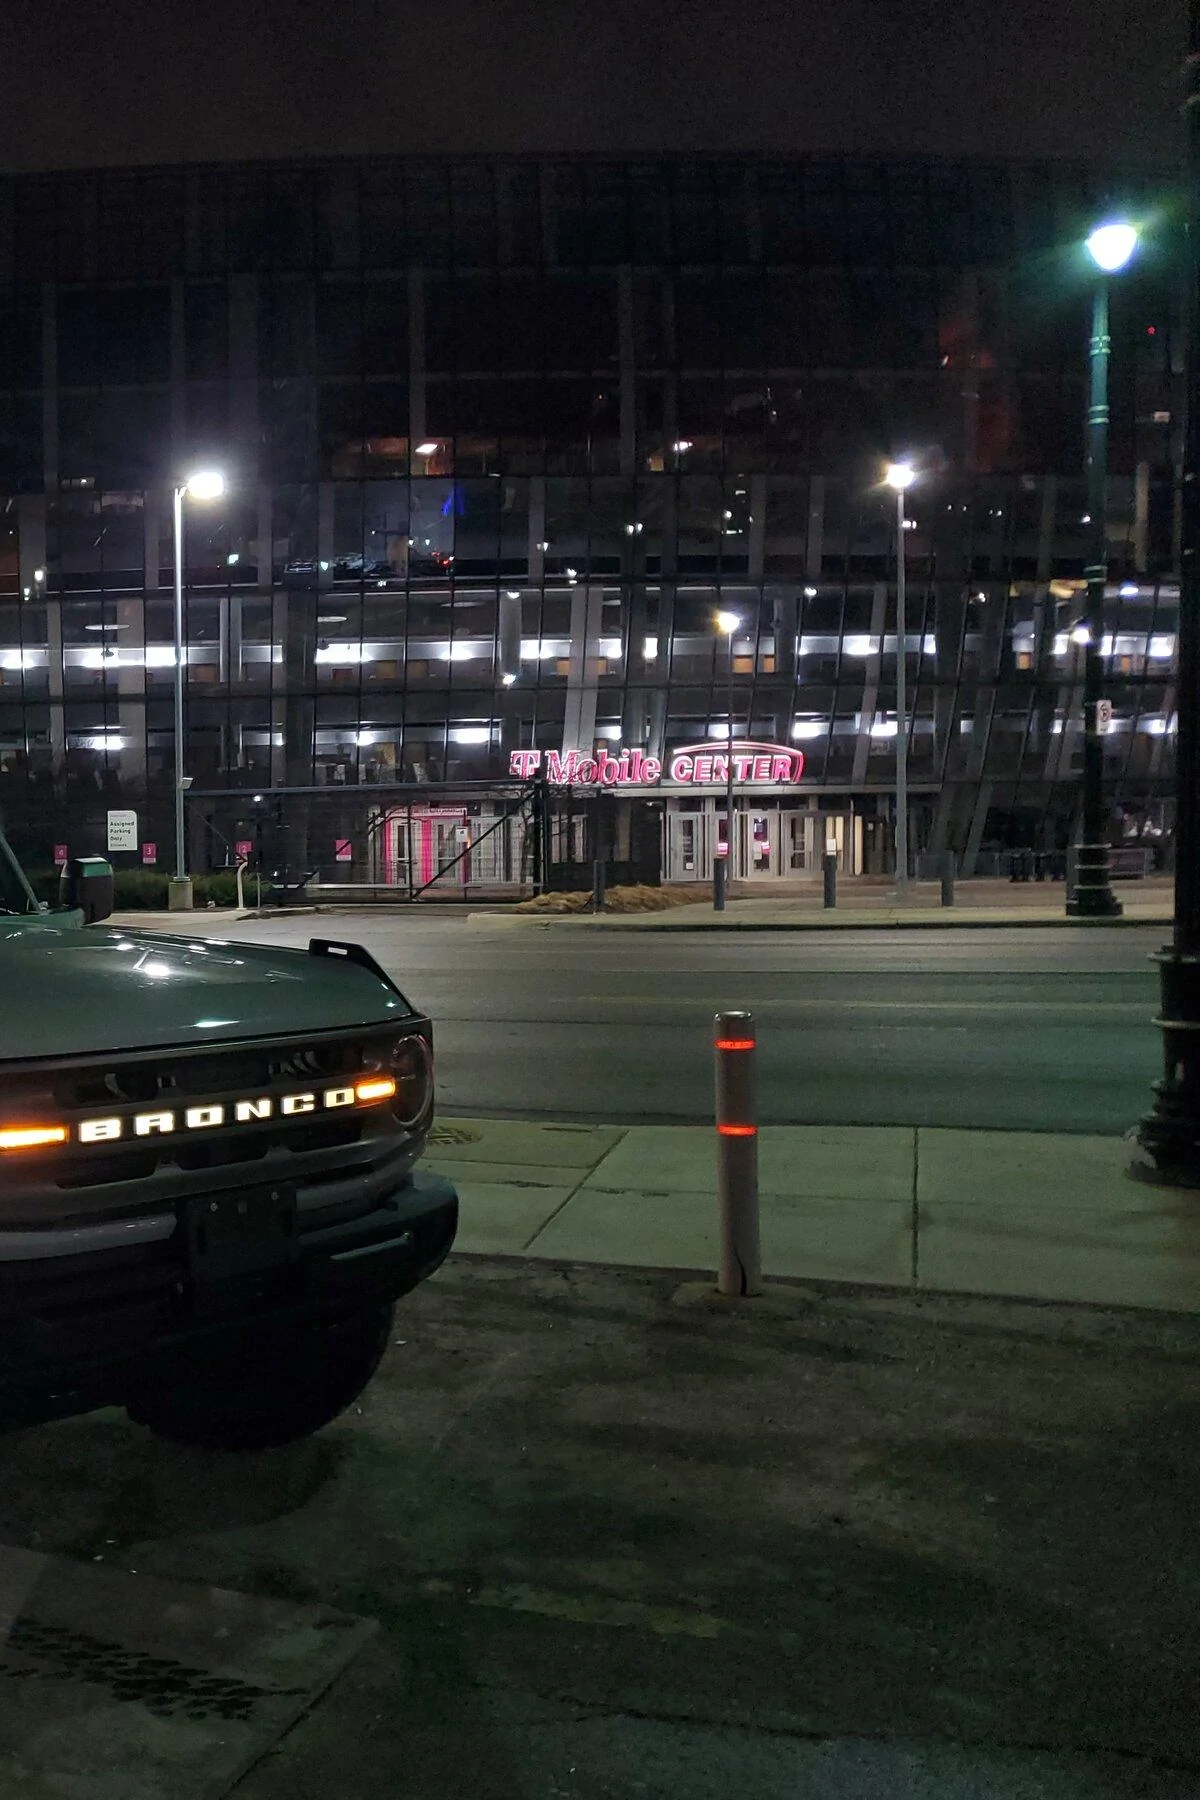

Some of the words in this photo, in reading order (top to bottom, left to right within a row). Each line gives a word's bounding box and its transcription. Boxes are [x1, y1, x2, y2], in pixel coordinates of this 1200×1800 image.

[545, 748, 661, 785] Mobile
[671, 754, 793, 782] CENTER
[78, 1088, 355, 1143] BRONCO
